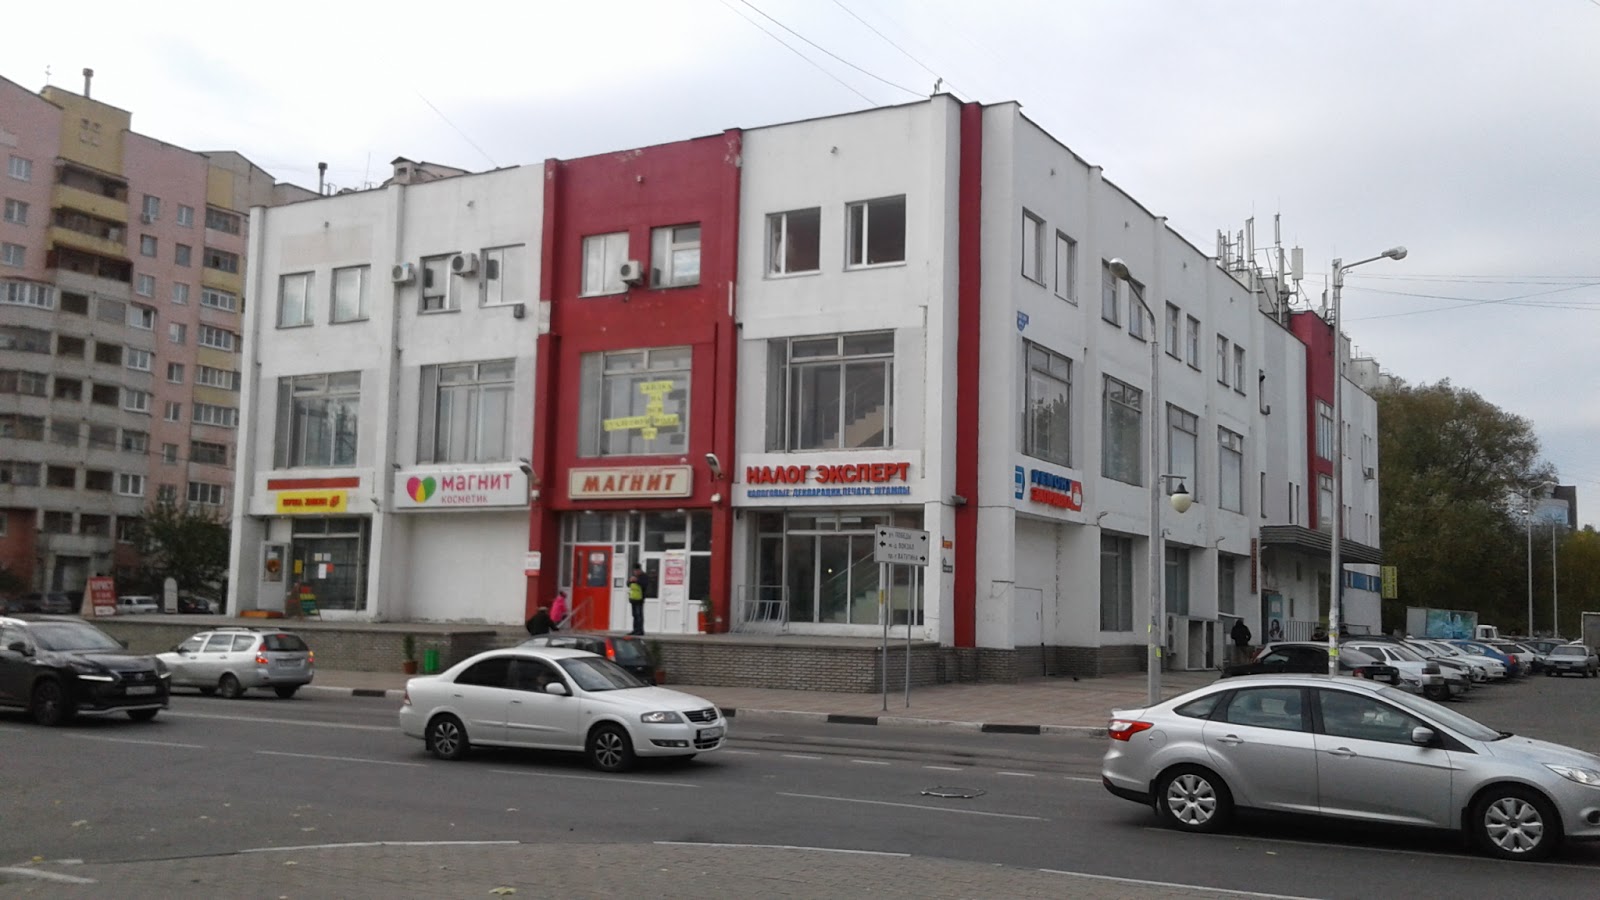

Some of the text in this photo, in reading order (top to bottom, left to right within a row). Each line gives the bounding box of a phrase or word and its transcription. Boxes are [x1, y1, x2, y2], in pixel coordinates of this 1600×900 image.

[747, 462, 911, 484] НАЛОГ ЭКСПЕРТ
[582, 474, 676, 492] МАГНИТ
[442, 494, 488, 504] косметик
[747, 489, 790, 498] НАЛОГОВЫЕ
